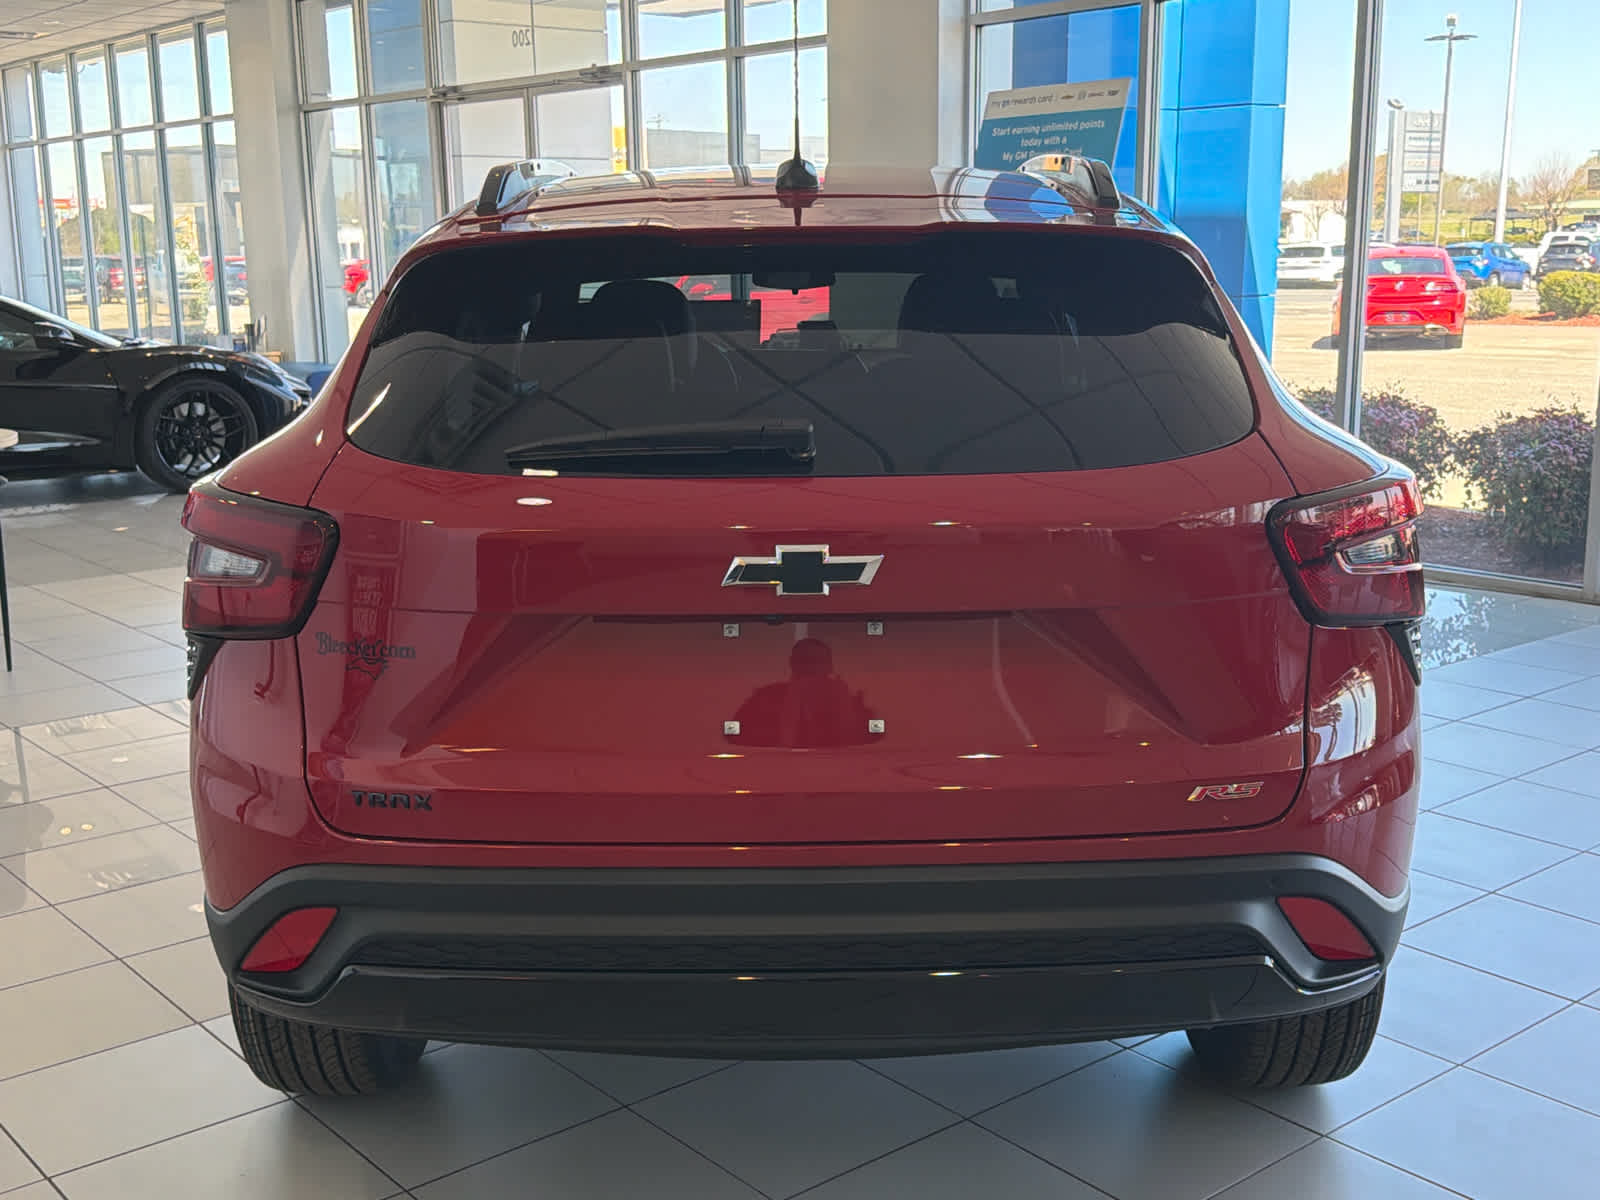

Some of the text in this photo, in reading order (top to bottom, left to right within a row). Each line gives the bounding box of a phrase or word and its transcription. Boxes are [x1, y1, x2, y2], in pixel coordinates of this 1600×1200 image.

[992, 120, 1105, 137] Start earning unlimited points
[1021, 137, 1041, 147] today
[1043, 136, 1061, 145] with
[1002, 151, 1013, 162] My
[1015, 150, 1027, 160] GM
[1187, 781, 1264, 802] RS
